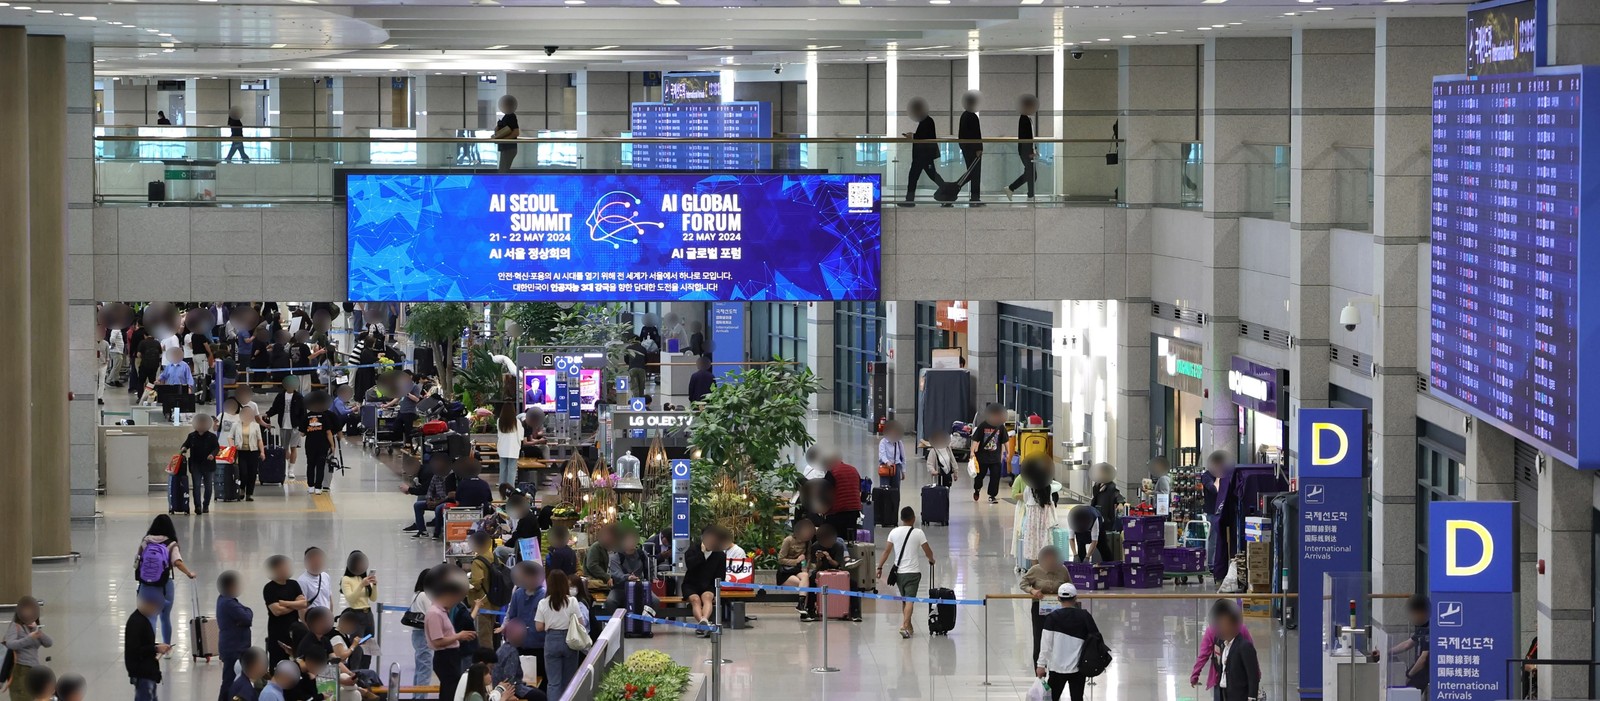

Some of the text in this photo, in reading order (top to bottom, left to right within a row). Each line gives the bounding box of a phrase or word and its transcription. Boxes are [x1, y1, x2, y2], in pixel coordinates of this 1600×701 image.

[489, 194, 559, 212] AI SEOUL
[661, 194, 741, 212] AI GLOBAL
[510, 213, 573, 231] SUMMIT
[682, 213, 741, 231] FORUM
[489, 233, 500, 242] 21
[509, 233, 521, 242] 22
[523, 233, 544, 242] MAY
[546, 233, 571, 242] 2024
[682, 233, 741, 241] 22 MAY 2024
[489, 247, 571, 260] AI 서울 정상회의
[671, 247, 741, 260] AI 글로벌 포럼
[553, 272, 561, 280] AI
[562, 271, 583, 281] 시대를
[585, 271, 600, 281] 열기
[601, 271, 616, 281] 위해
[617, 271, 625, 280] 전
[626, 271, 648, 280] 세계가
[649, 271, 678, 280] 서울에서
[679, 271, 701, 280] 하나로
[702, 271, 733, 280] 모입니다.
[512, 283, 718, 292] 대한민국이 인공지능 3대 강국을 향한 담대한 도전을 시작합니다!
[629, 416, 645, 426] LG
[647, 416, 676, 426] OLED
[1312, 422, 1349, 466] D
[1304, 511, 1348, 521] 국제선도착
[1445, 519, 1494, 577] D
[1437, 637, 1494, 650] 국제선도착
[1437, 667, 1480, 677] 国际线到达
[1437, 681, 1499, 690] International
[1437, 691, 1472, 700] Arrivals
